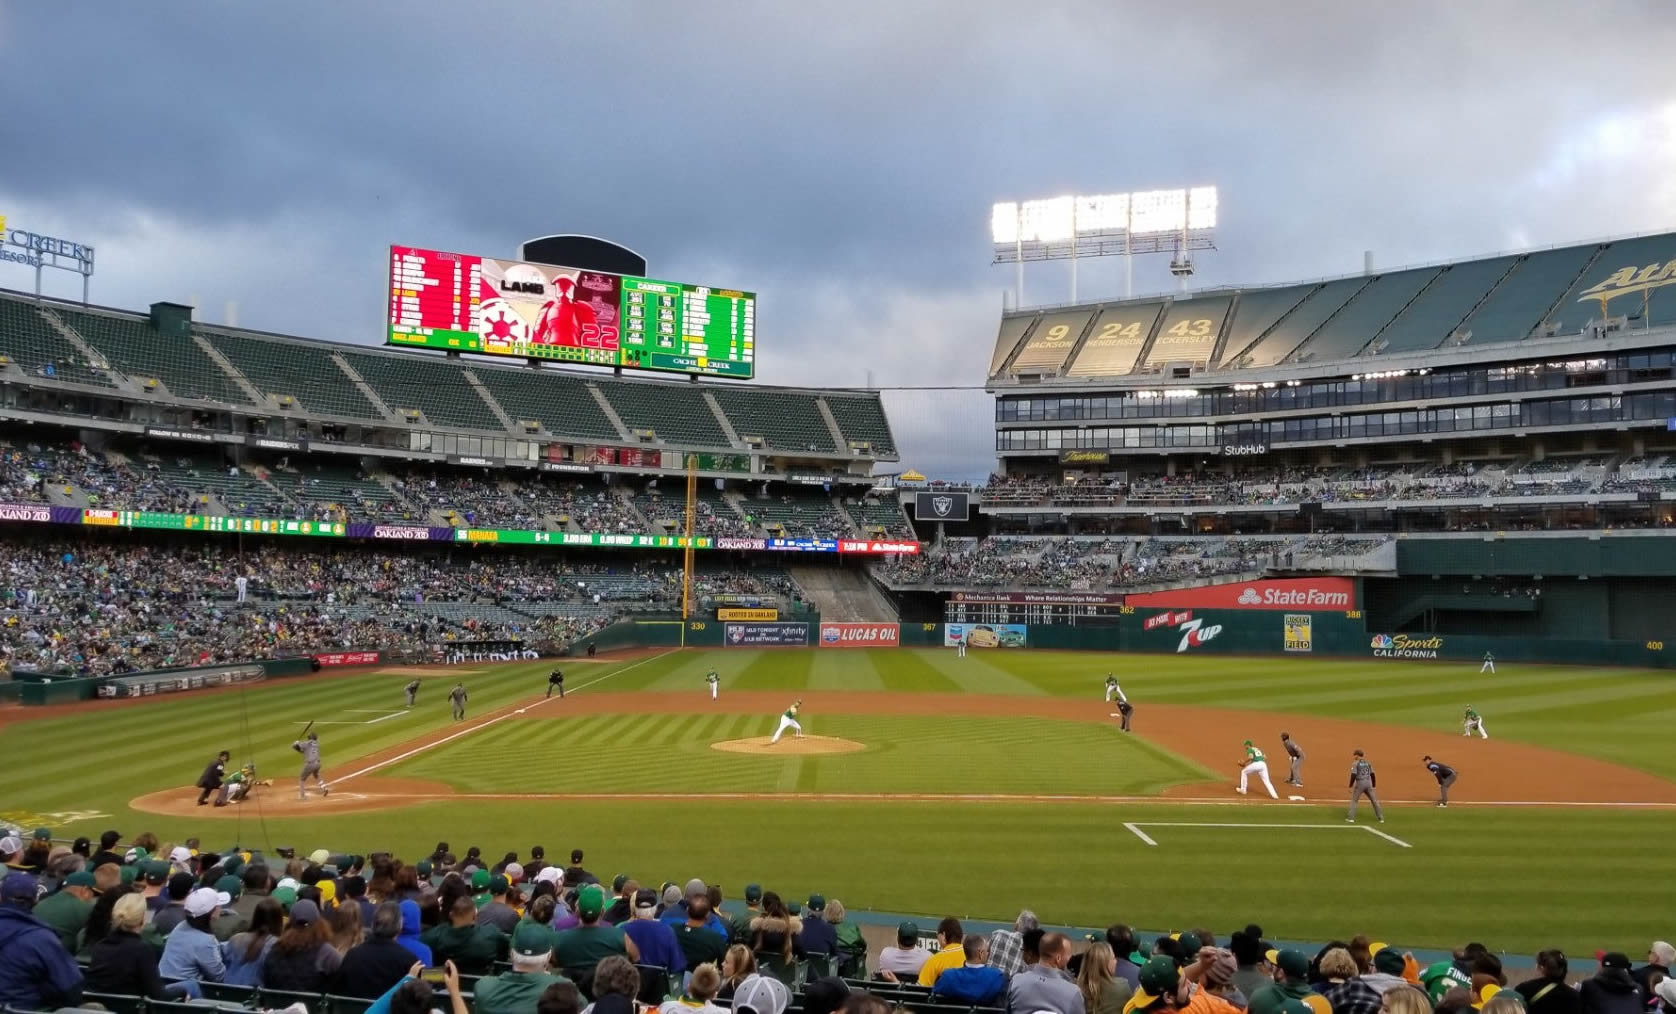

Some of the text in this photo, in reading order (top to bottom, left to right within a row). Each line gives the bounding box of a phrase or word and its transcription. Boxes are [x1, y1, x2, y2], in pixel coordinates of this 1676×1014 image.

[501, 280, 545, 295] LAMB
[1045, 325, 1070, 341] 9
[1098, 322, 1141, 339] 24
[1168, 319, 1212, 336] 43
[580, 323, 619, 350] 22
[1086, 338, 1142, 346] HENDERSON
[1155, 335, 1216, 345] ECKERSLEY
[1026, 341, 1074, 349] JACKSON
[1225, 444, 1264, 456] StubHub
[32, 512, 51, 522] ZOO
[374, 530, 413, 538] OAKLAND
[1263, 588, 1348, 605] State Farm
[782, 627, 806, 636] xfinity
[841, 628, 878, 640] LUCAS
[880, 628, 896, 640] OIL
[1176, 618, 1223, 653] 7 UP
[1393, 634, 1443, 652] Sports
[1647, 641, 1663, 650] 400
[1373, 649, 1437, 658] CALIFORNIA
